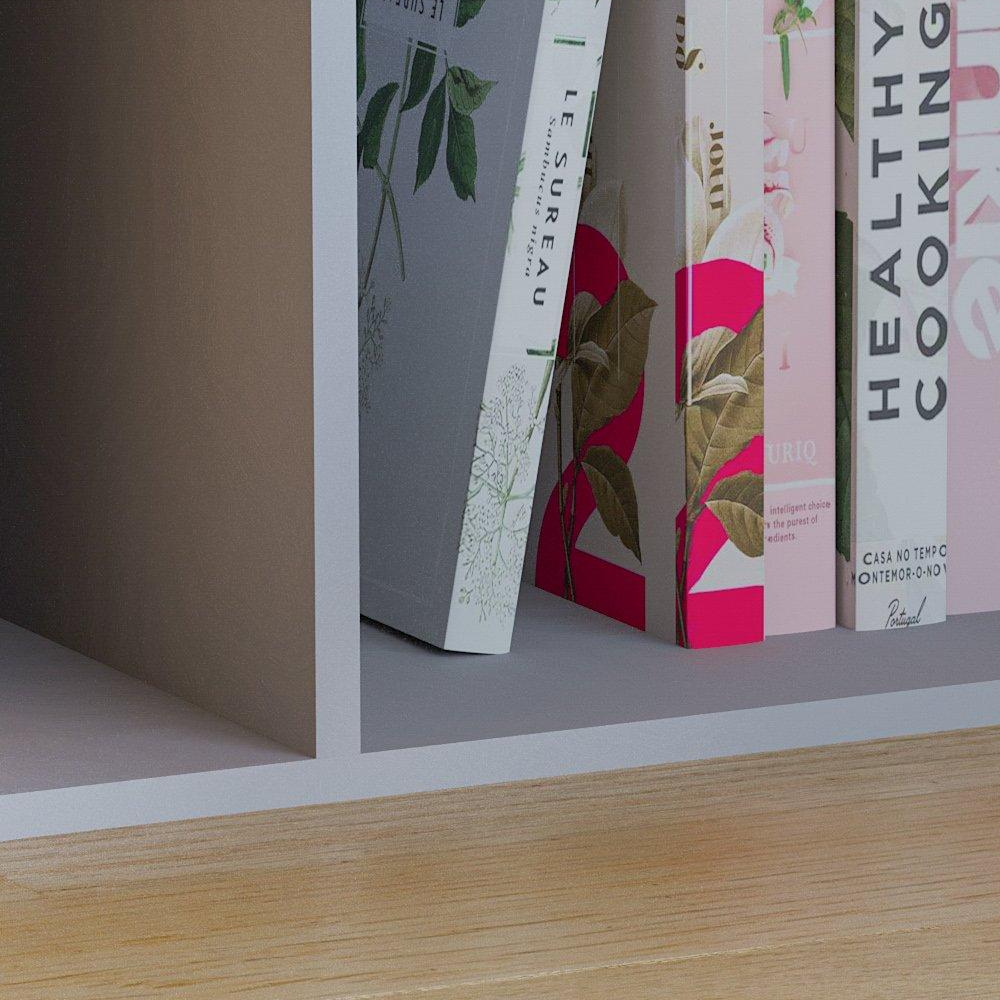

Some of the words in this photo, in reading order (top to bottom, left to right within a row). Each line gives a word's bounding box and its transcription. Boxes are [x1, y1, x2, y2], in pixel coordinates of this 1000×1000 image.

[561, 89, 578, 127] LE
[534, 115, 556, 216] Sambucus
[532, 151, 568, 306] SUREAU
[868, 11, 904, 421] HEALTHY
[914, 2, 951, 421] COOKING
[524, 224, 538, 277] nigra
[770, 502, 807, 515] intelligent
[808, 499, 832, 511] choice
[773, 520, 785, 529] the
[787, 517, 809, 530] purest
[811, 515, 818, 525] of
[863, 552, 892, 565] CASA
[897, 549, 910, 562] NO
[914, 544, 947, 559] TEMPO
[884, 596, 927, 630] Portugal
